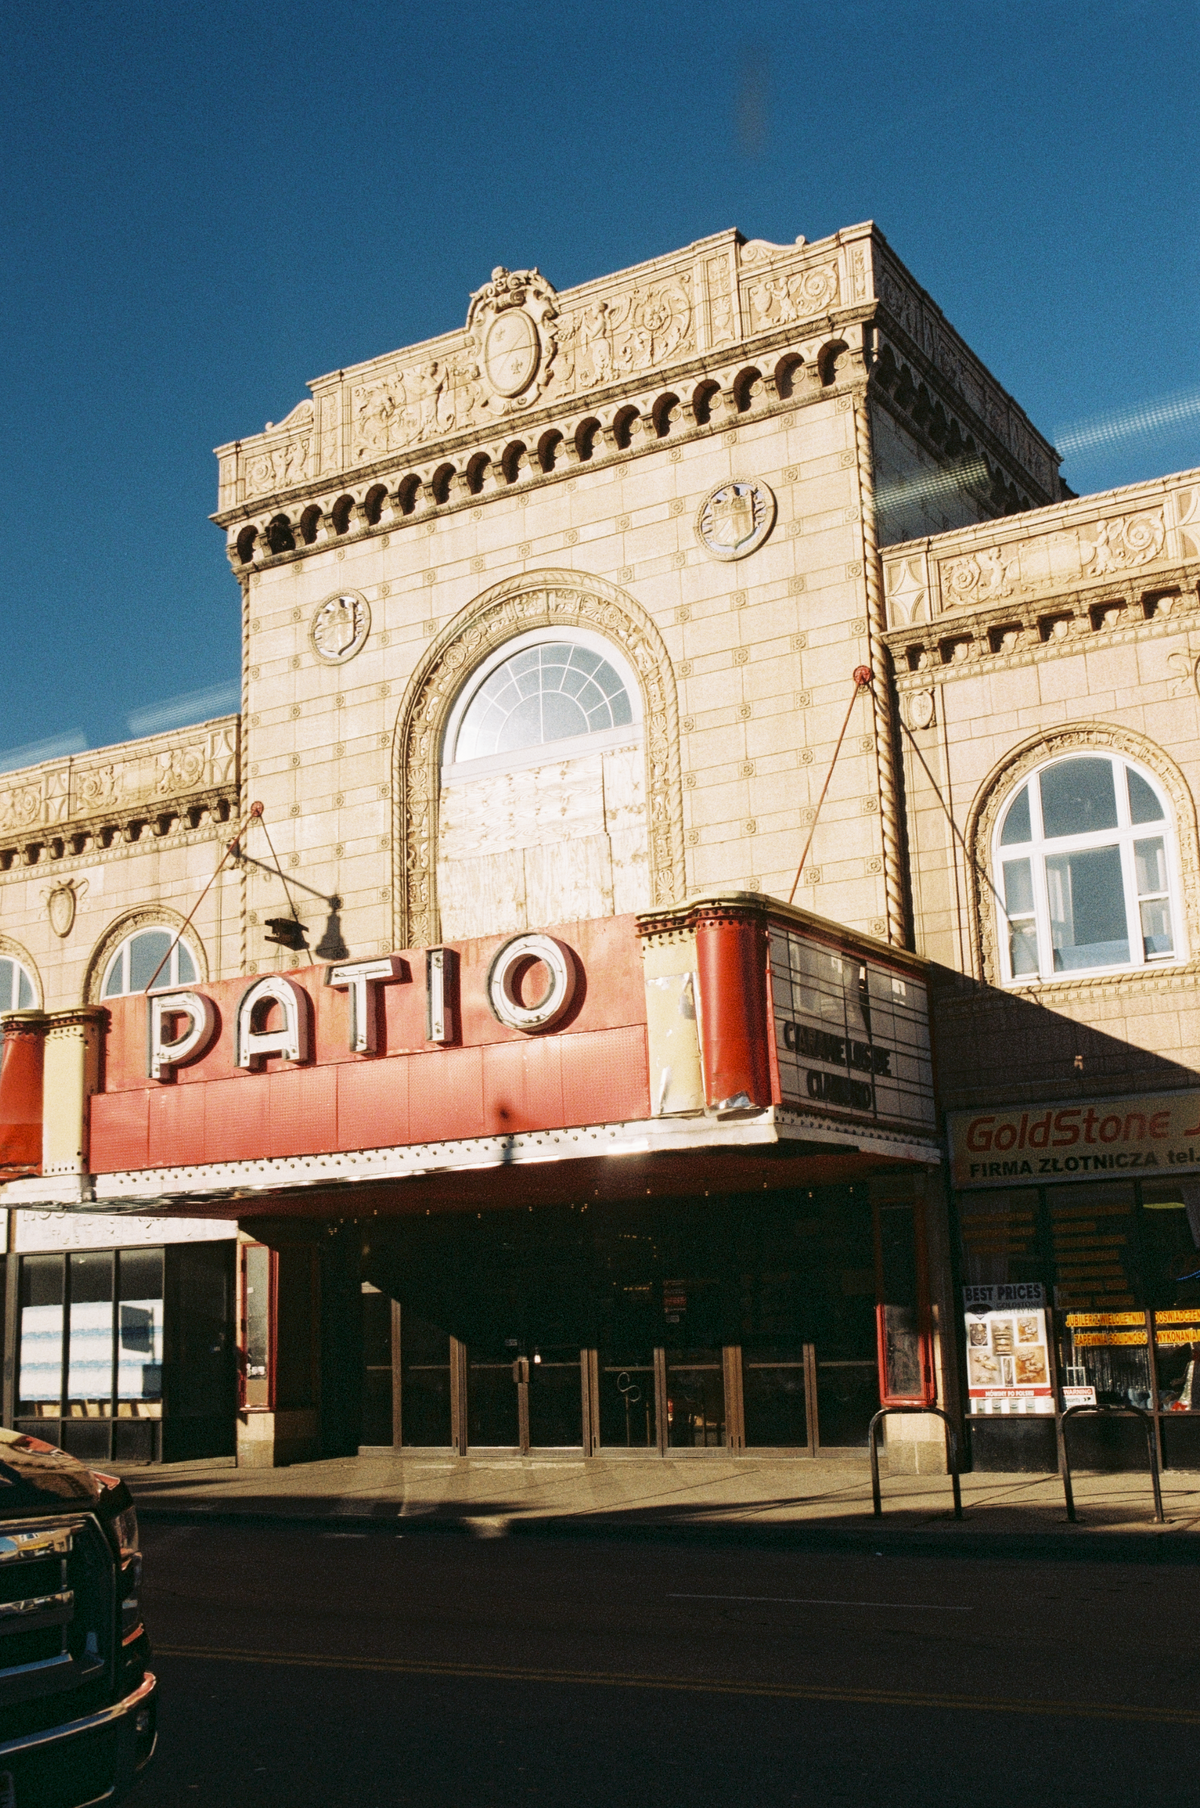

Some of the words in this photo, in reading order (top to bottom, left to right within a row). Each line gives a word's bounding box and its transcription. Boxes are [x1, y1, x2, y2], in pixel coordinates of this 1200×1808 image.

[147, 932, 580, 1081] PATIO
[970, 1160, 1033, 1177] FIRMA
[1039, 1152, 1158, 1173] ZŁOTNICZA
[1167, 1147, 1200, 1164] tel.
[965, 1287, 993, 1302] BEST
[997, 1284, 1041, 1301] PRICES
